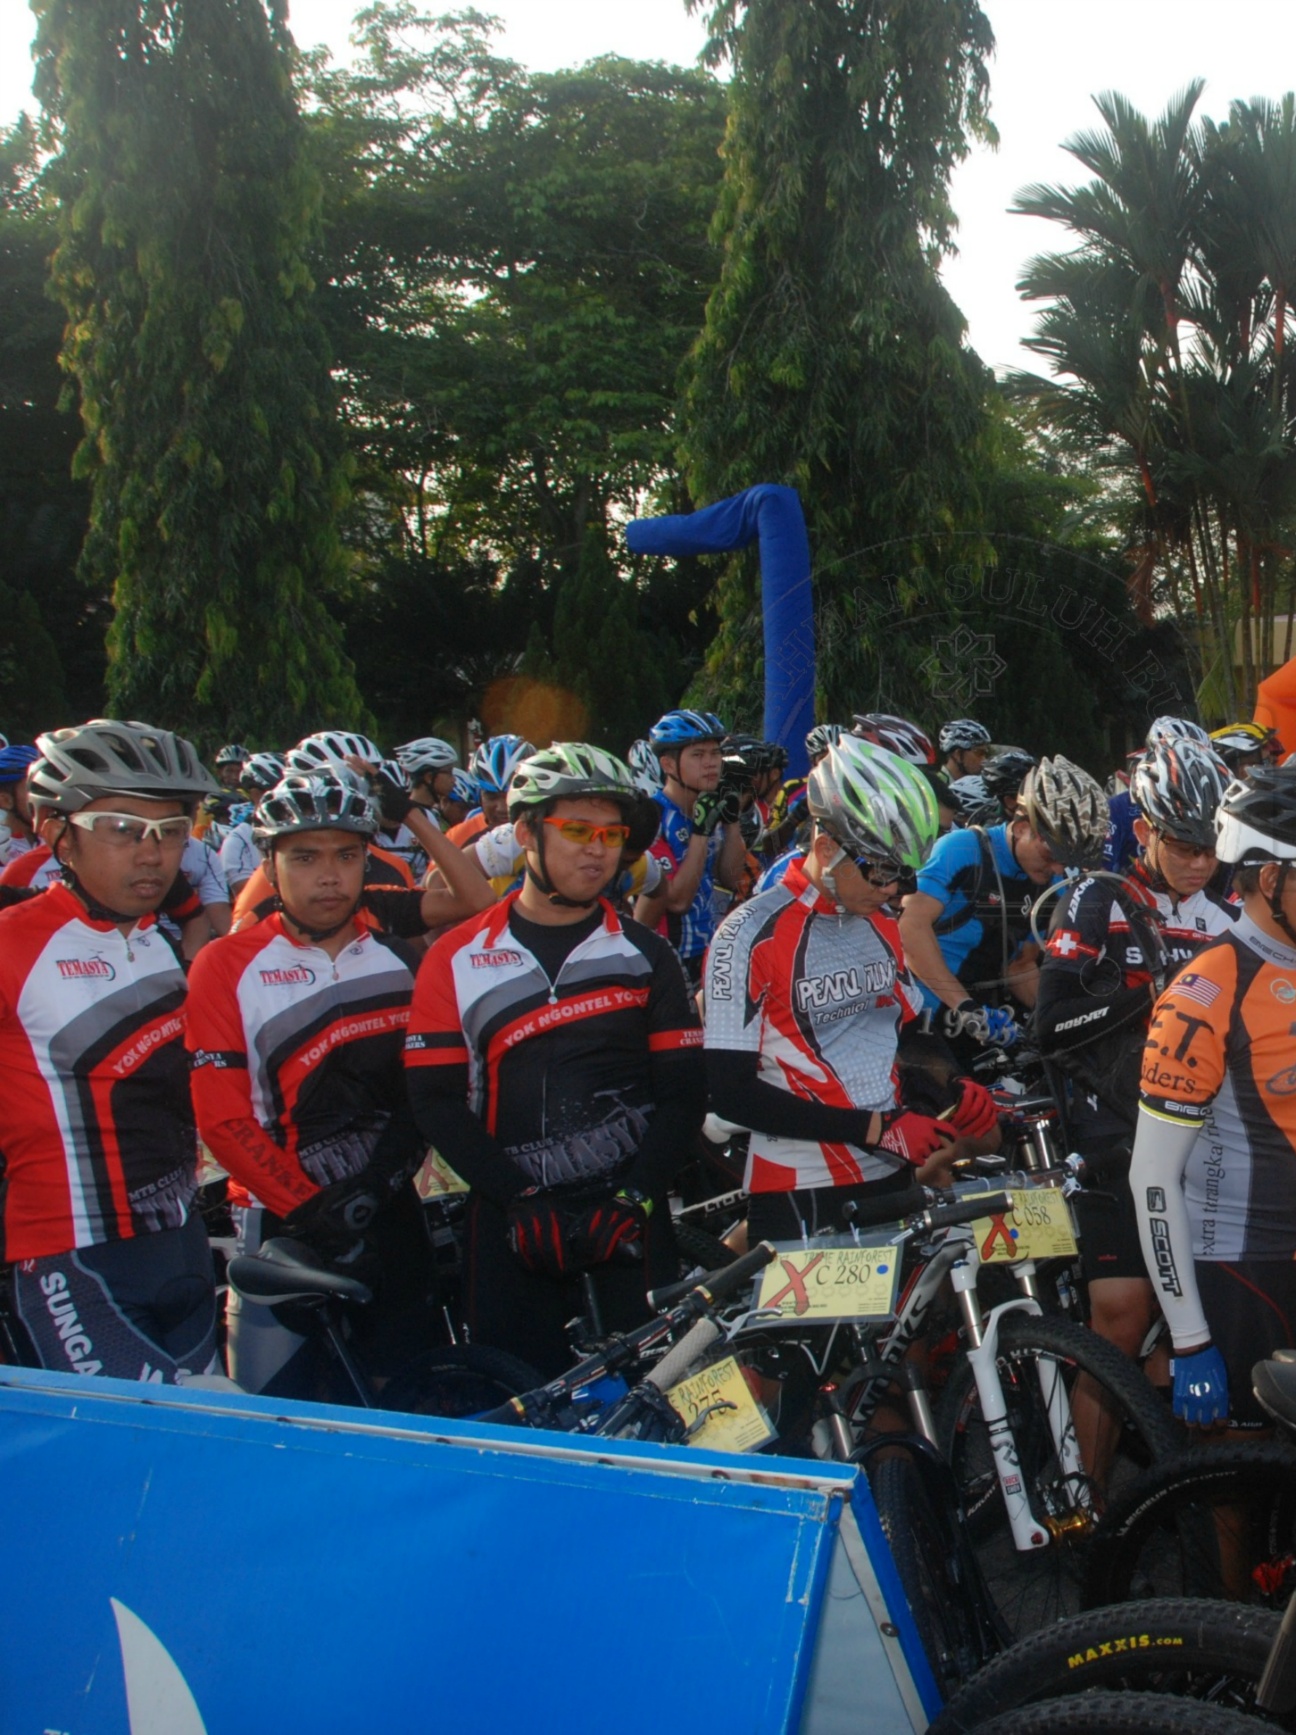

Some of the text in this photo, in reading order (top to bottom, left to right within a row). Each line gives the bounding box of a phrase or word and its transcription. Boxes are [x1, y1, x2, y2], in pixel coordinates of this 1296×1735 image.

[57, 960, 110, 977] TEMASYA
[260, 968, 309, 985] TEMASYA
[797, 967, 862, 1012] PEARL
[504, 1021, 532, 1047] YOK
[538, 995, 612, 1028] NGONTEL
[299, 1039, 329, 1067] YOK
[330, 1017, 386, 1045] NGONTEL
[112, 1047, 141, 1075] YOK
[1024, 1205, 1052, 1226] 058
[836, 1248, 896, 1265] RAINFOREST
[1149, 1216, 1183, 1298] SCOTT
[815, 1263, 872, 1286] C 280
[677, 1360, 736, 1405] RAINFOREST
[1068, 1634, 1183, 1668] MAXXIS.COM
